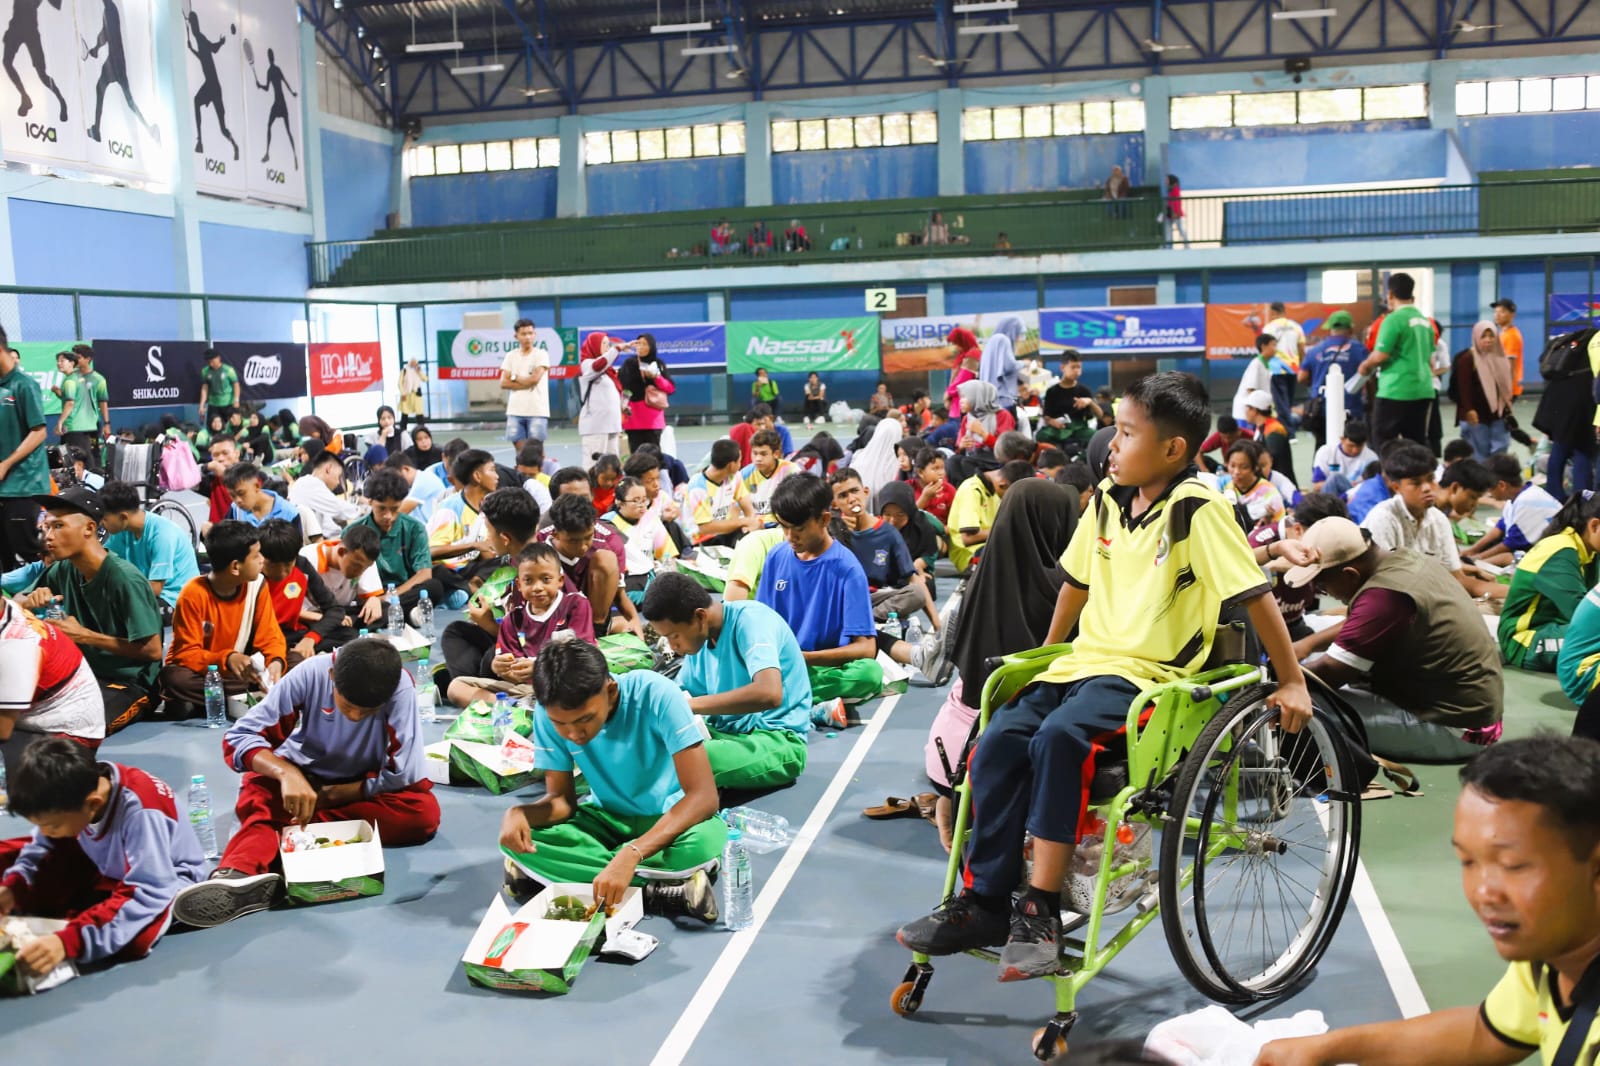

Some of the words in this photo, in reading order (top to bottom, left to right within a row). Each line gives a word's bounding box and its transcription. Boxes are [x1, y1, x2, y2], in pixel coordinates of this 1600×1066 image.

[874, 292, 887, 308] 2
[1054, 321, 1117, 338] BSI
[485, 341, 499, 353] RS
[132, 387, 180, 400] SHIKA.CO.ID
